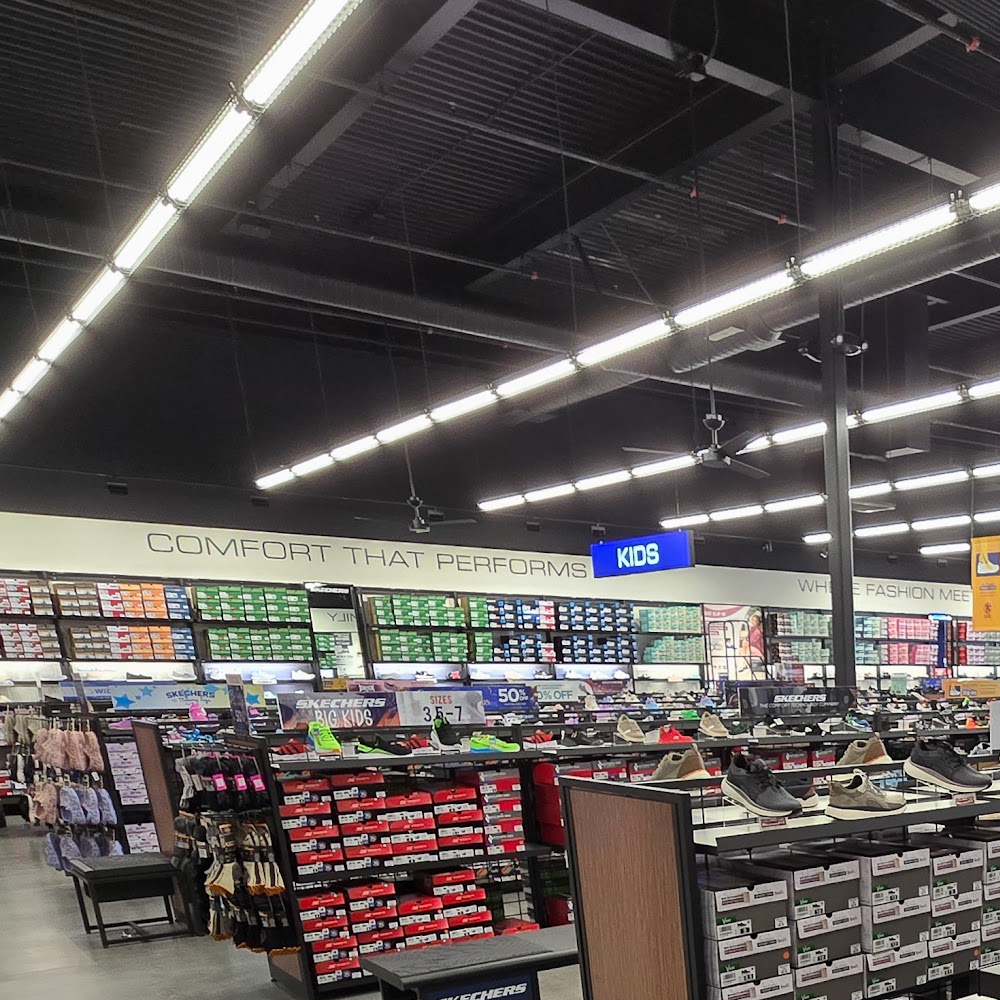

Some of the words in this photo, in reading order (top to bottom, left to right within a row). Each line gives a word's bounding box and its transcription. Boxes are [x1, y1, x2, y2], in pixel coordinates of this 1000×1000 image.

[147, 532, 331, 563] COMFORT
[343, 547, 425, 569] THAT
[437, 555, 588, 579] PERFORMS
[616, 543, 660, 568] KIDS
[797, 578, 861, 596] WHE
[866, 581, 935, 601] FASHION
[166, 690, 215, 699] SKECHERS
[429, 695, 453, 705] SIZES
[553, 690, 573, 700] OFF
[774, 693, 827, 702] SKECHERS
[296, 698, 386, 709] SKECHERS
[315, 709, 338, 726] BIG
[342, 708, 373, 725] KIDS
